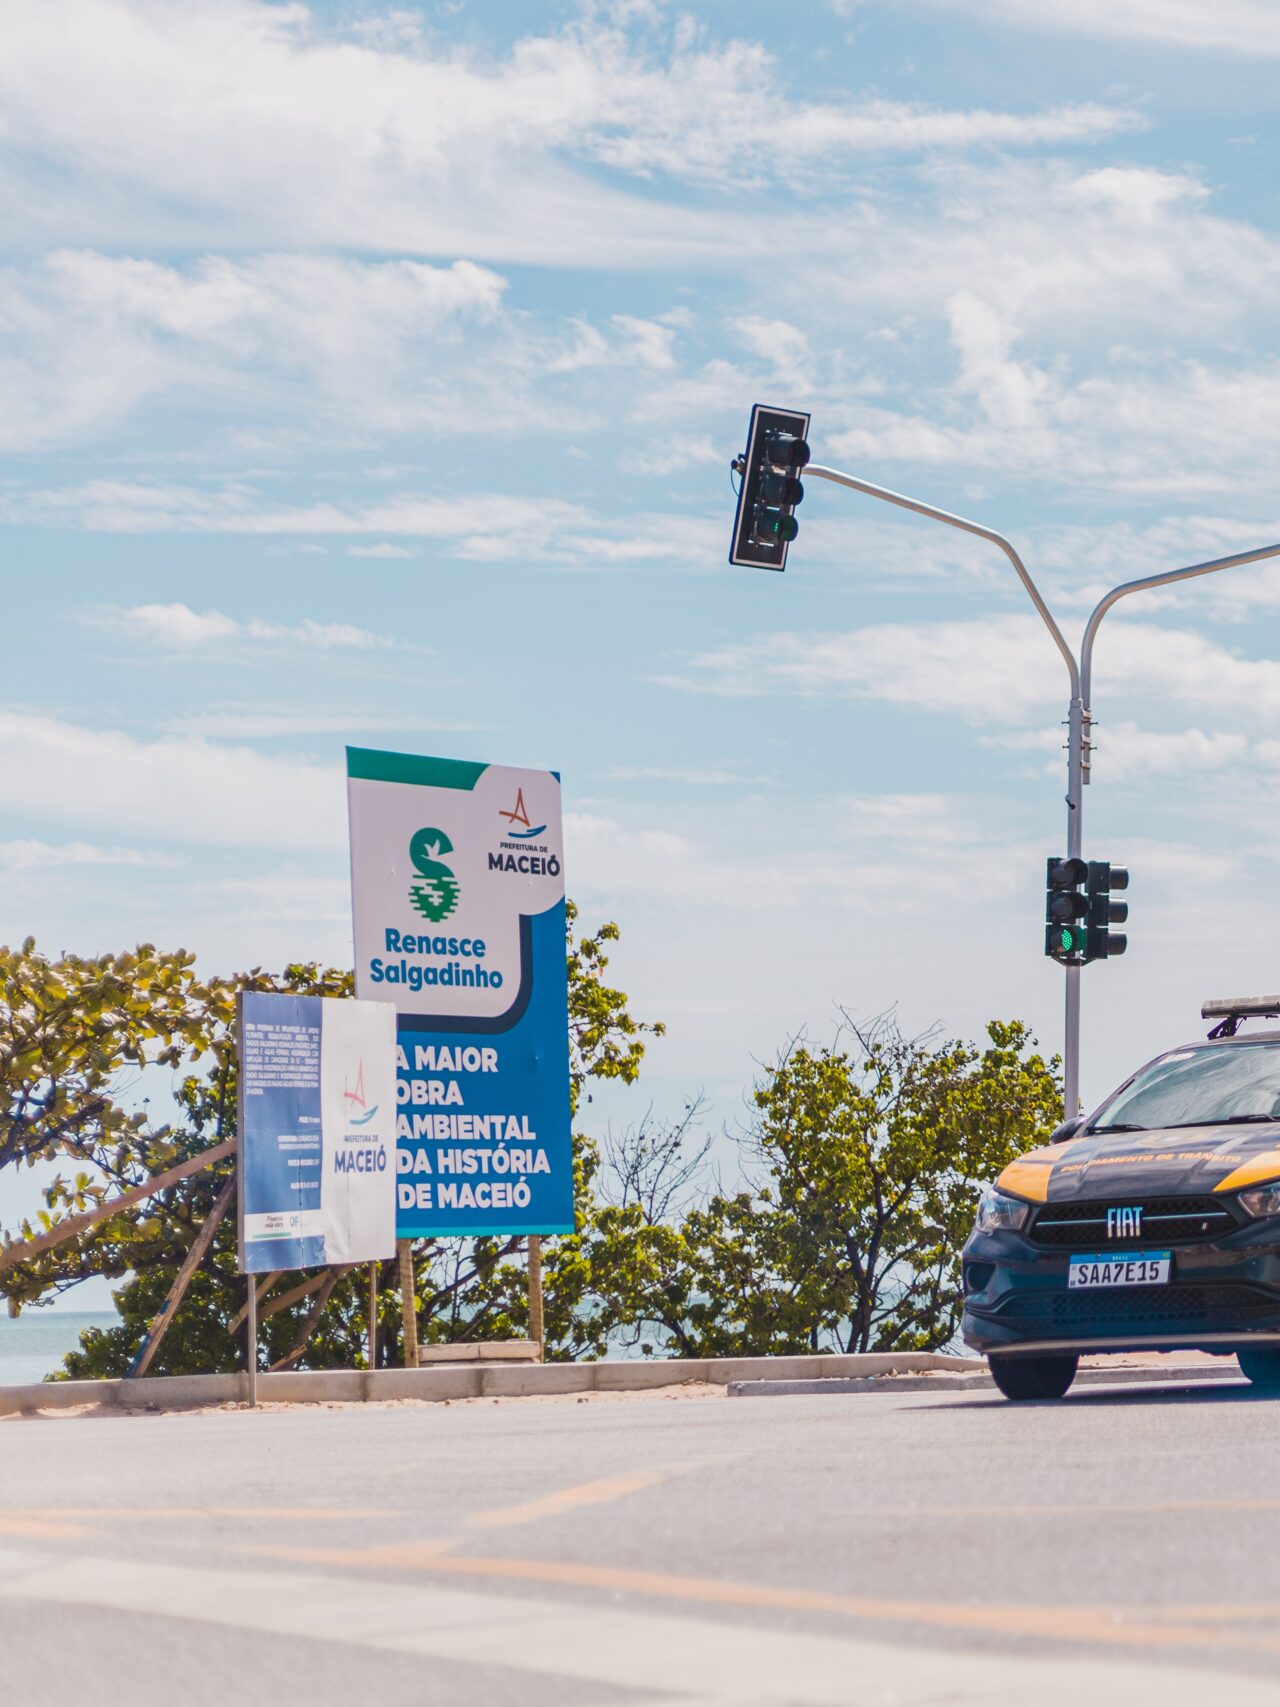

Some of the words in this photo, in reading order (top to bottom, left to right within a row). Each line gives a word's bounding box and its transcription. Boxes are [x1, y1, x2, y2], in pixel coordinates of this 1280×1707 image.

[500, 841, 538, 852] PREFEITURA
[539, 845, 548, 853] DE
[488, 851, 560, 876] MACEIÓ
[385, 927, 486, 957] Renasce
[370, 958, 503, 991] Salgadinho
[396, 1044, 409, 1071] A
[414, 1044, 498, 1072] MAIOR
[396, 1079, 464, 1105] OBRA
[396, 1113, 536, 1140] AMBIENTAL
[334, 1144, 386, 1173] MACEIÓ
[396, 1148, 432, 1174] DA
[437, 1142, 551, 1174] HISTÓRIA
[1156, 1152, 1175, 1161] DE
[398, 1183, 432, 1209] DE
[437, 1175, 531, 1209] MACEIÓ
[1107, 1206, 1143, 1238] FIAT
[1078, 1261, 1160, 1285] SAA7E15
